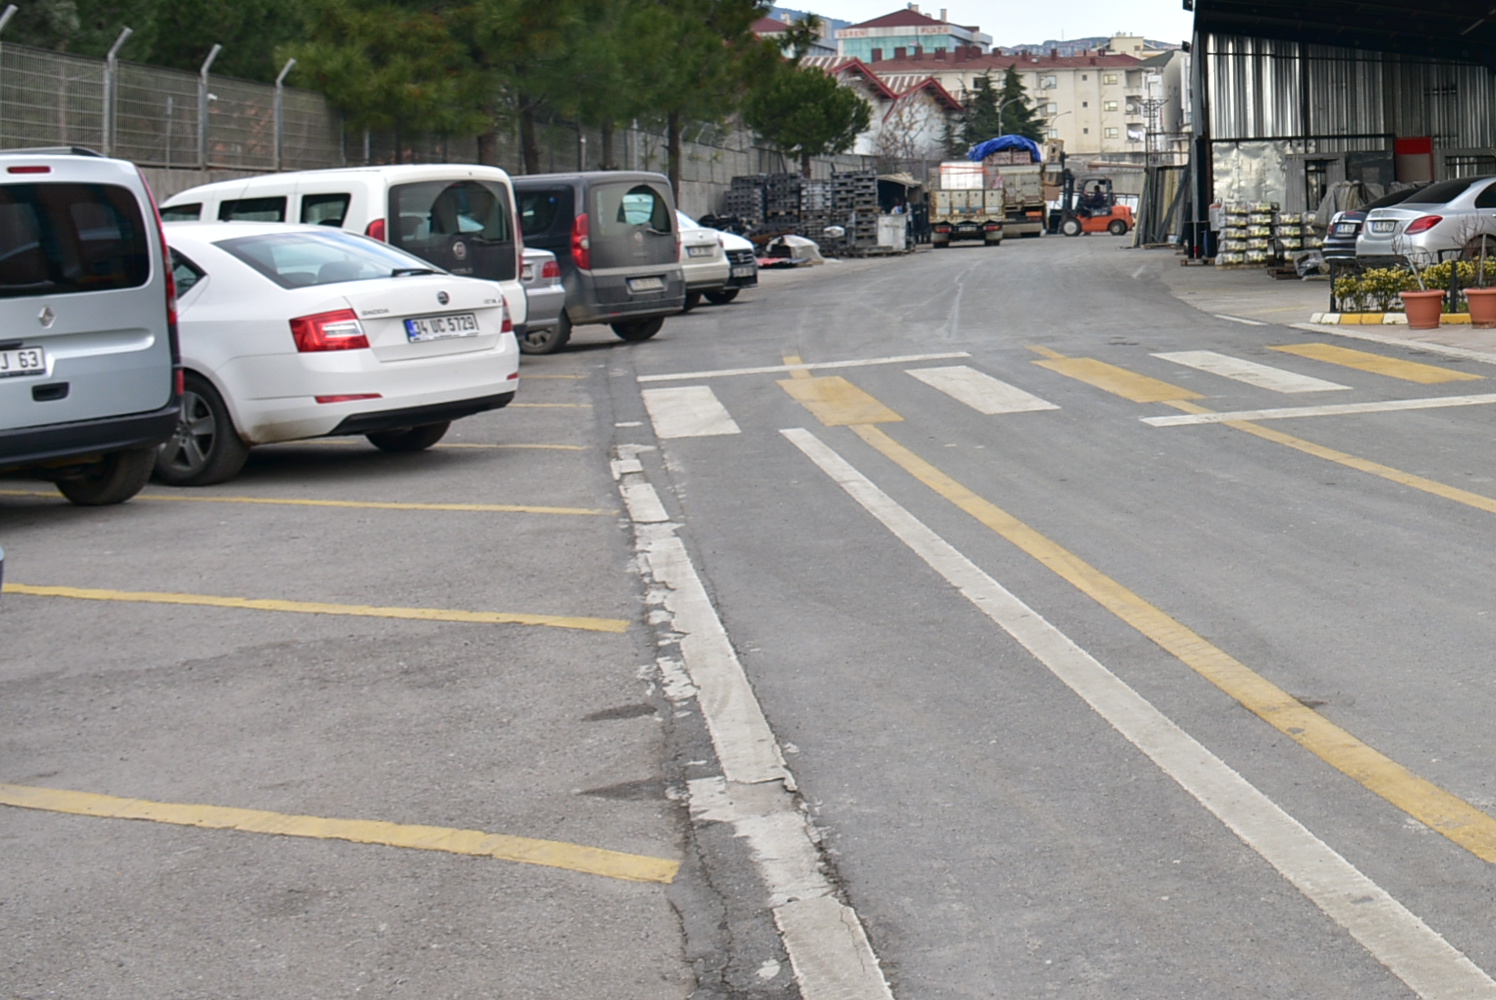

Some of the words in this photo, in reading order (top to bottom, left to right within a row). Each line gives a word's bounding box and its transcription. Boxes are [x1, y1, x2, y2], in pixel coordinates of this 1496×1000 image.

[413, 321, 428, 335] 34
[430, 319, 446, 333] UC
[447, 316, 475, 331] 5729
[18, 350, 39, 368] 63
